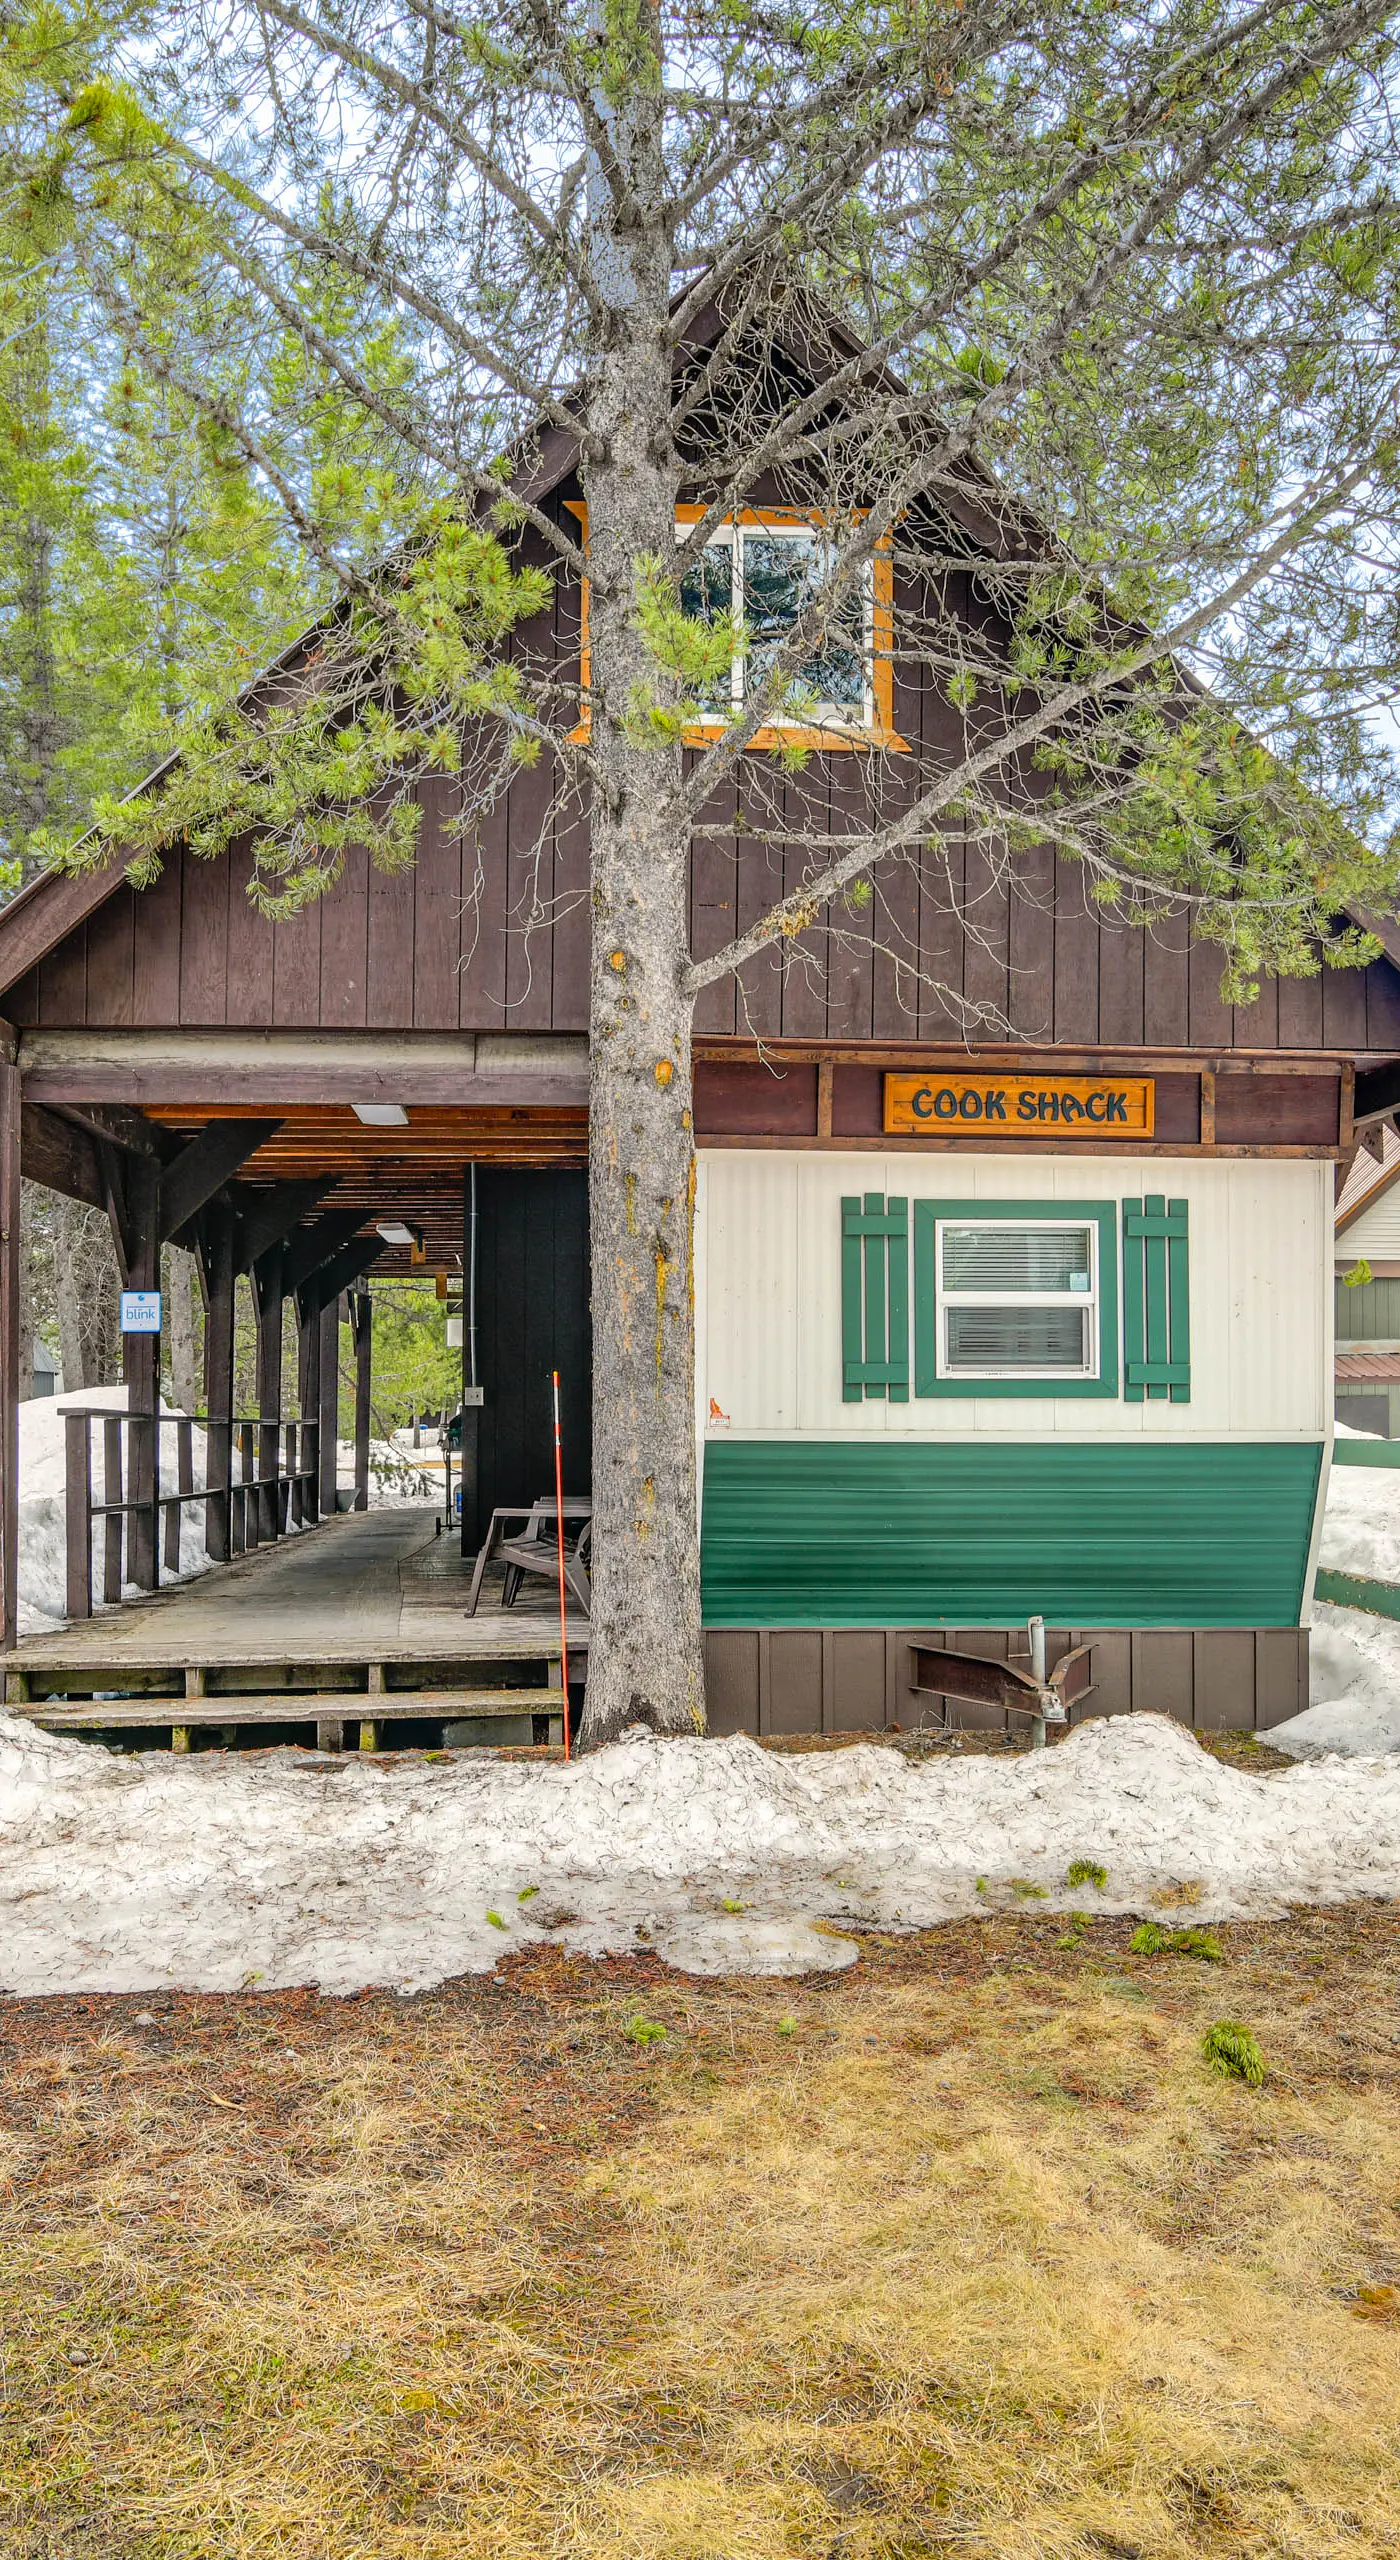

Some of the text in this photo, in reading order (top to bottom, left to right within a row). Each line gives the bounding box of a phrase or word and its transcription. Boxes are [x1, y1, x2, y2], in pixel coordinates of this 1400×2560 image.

[912, 1088, 1127, 1123] COOK SHACK
[126, 1308, 156, 1320] blink
